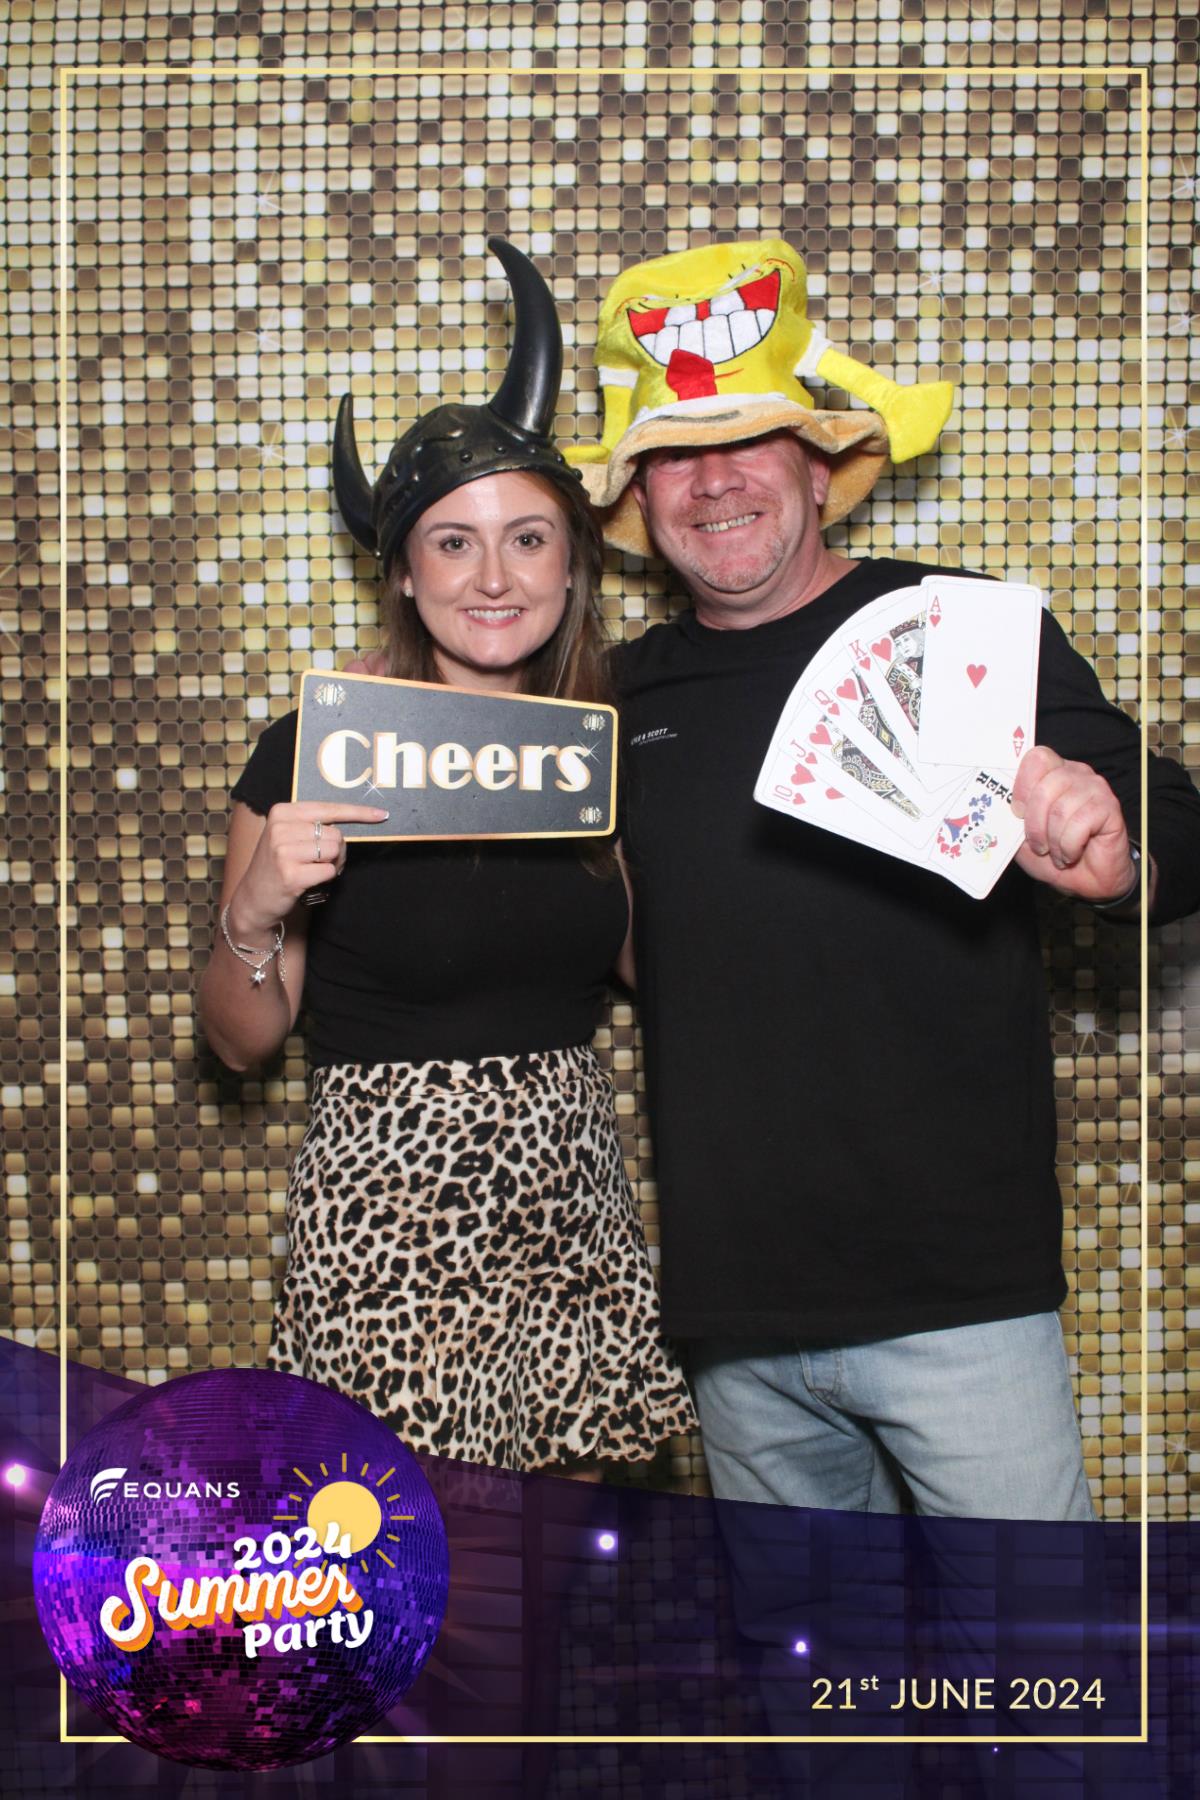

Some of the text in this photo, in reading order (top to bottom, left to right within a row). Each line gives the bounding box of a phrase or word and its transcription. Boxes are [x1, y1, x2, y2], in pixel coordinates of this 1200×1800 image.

[930, 595, 941, 612] A
[849, 639, 868, 659] K
[814, 689, 834, 706] Q
[647, 728, 668, 738] SCOTT
[790, 739, 807, 758] J
[1012, 741, 1024, 757] A
[317, 729, 592, 792] Cheers
[772, 784, 793, 802] 10
